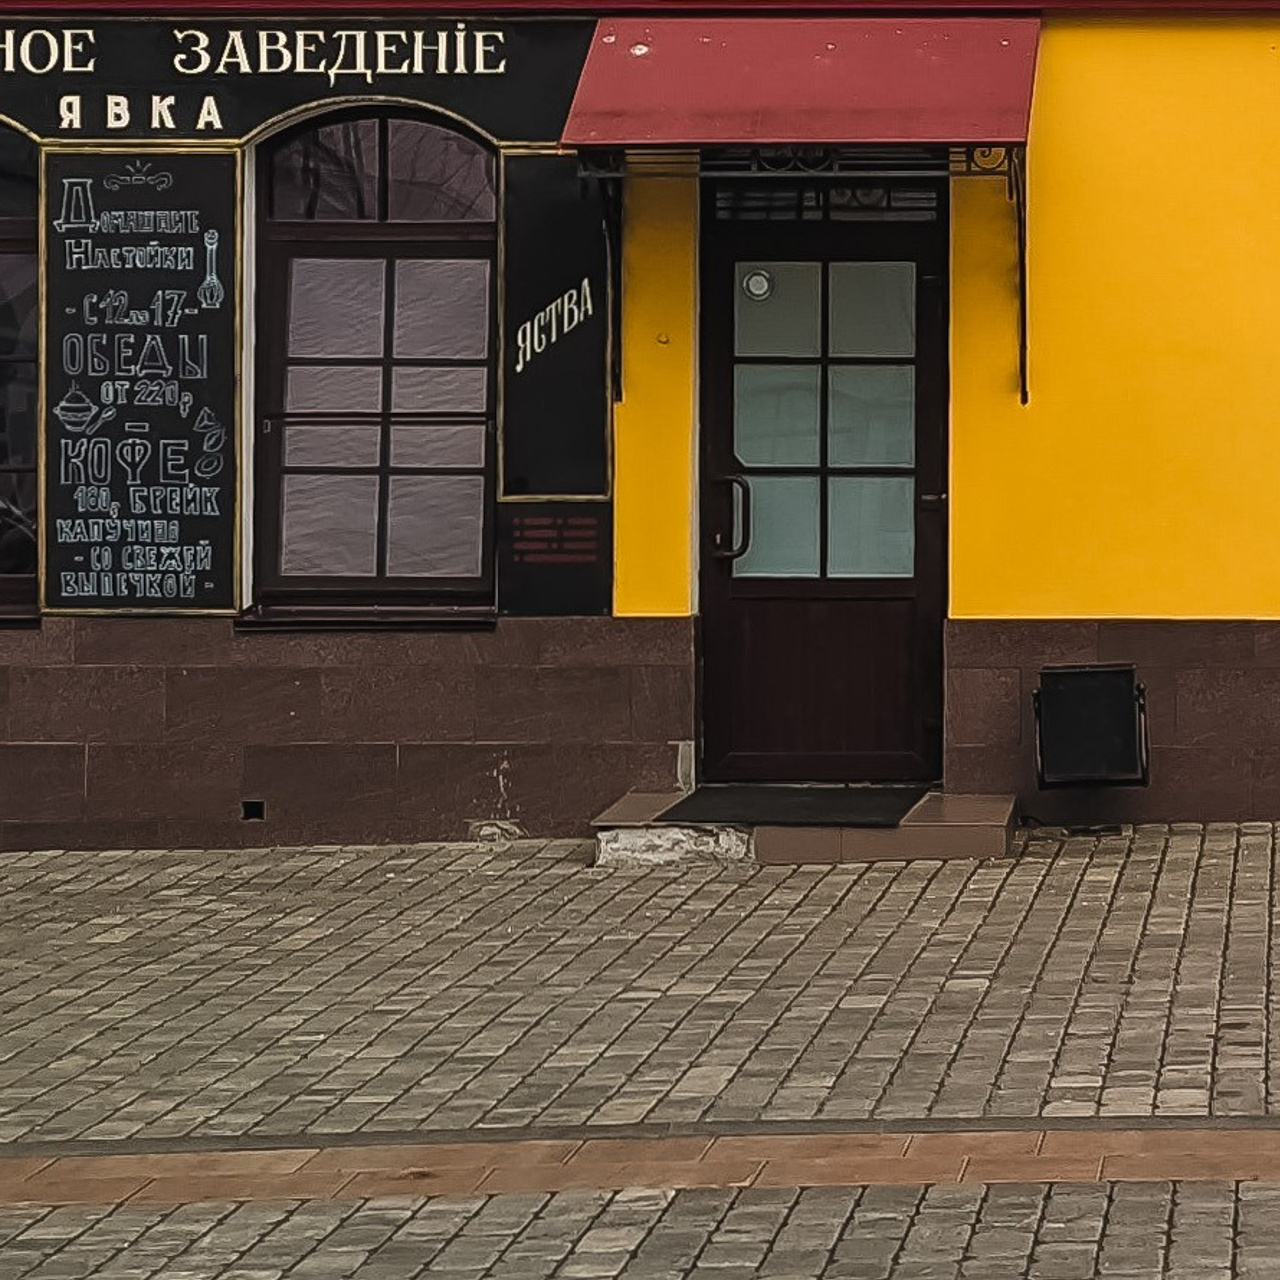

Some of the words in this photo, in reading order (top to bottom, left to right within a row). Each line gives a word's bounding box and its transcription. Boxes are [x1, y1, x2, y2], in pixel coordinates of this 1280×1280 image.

[59, 95, 223, 129] ЯВКА
[516, 278, 592, 372] ЯСТВА
[62, 333, 208, 379] ОБЕДЫ
[60, 438, 188, 484] КОФЕ
[129, 482, 220, 516] БРЕЙК
[122, 538, 212, 573] СВЕЖЕЙ
[60, 569, 196, 598] ВЫПЕЧКОЙ
